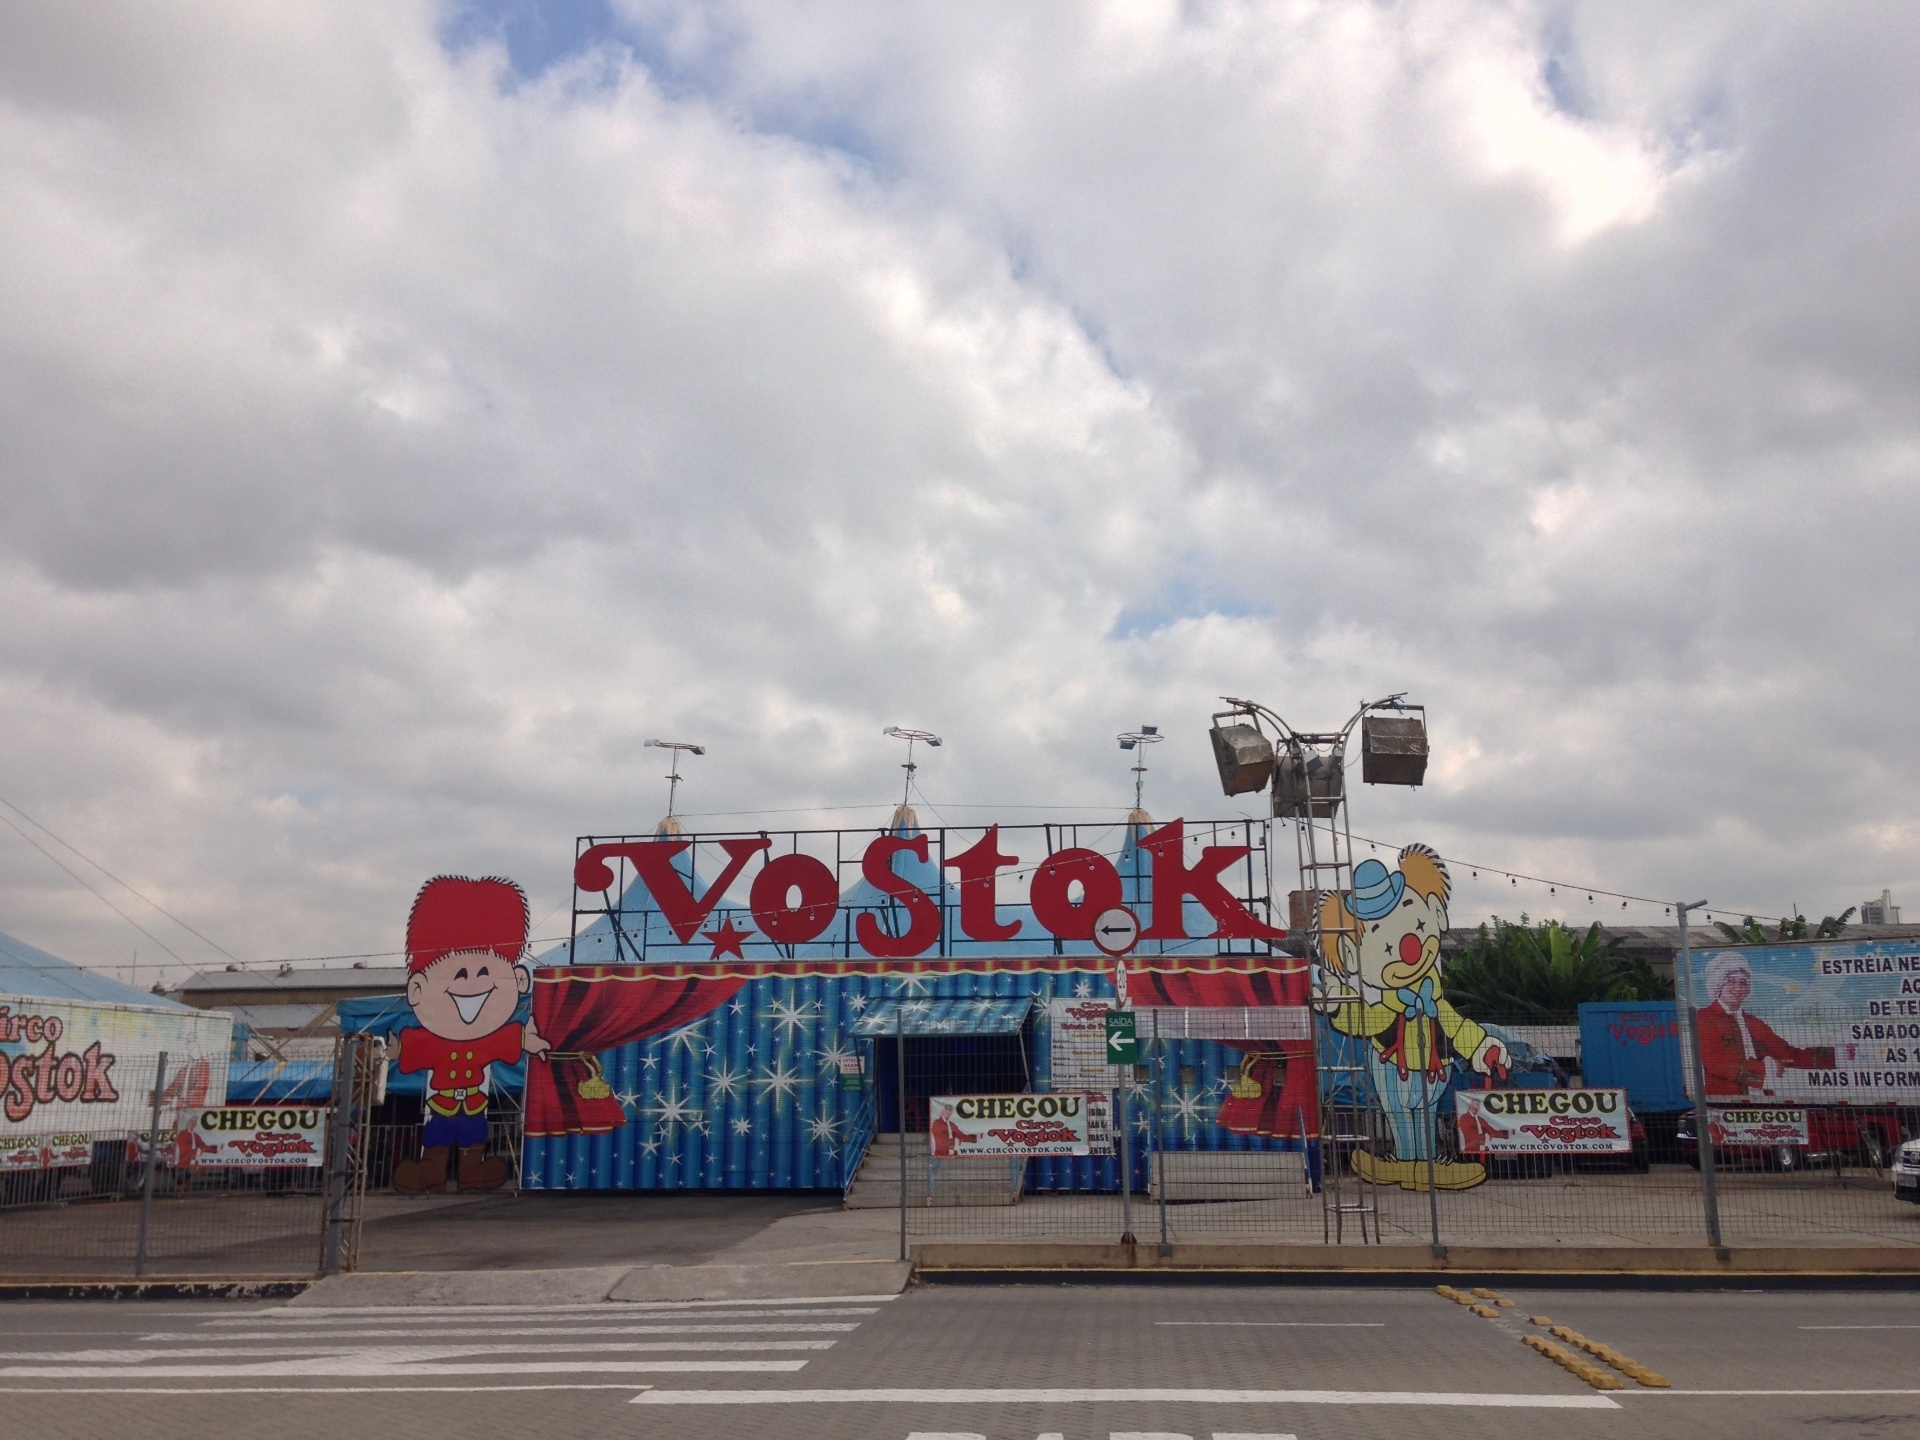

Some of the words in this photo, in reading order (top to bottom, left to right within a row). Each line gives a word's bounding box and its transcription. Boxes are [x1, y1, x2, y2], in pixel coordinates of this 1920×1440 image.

[1822, 954, 1893, 975] ESTRÉIA
[1869, 1001, 1892, 1016] DE
[0, 1006, 63, 1043] irco
[1108, 1015, 1133, 1025] SAÍDA
[1886, 1048, 1907, 1063] AS
[1808, 1072, 1849, 1087] MAIS
[956, 1097, 1081, 1119] CHEGOU
[1483, 1091, 1618, 1115] CHEGOU
[200, 1110, 320, 1131] CHEGOU
[1015, 1119, 1065, 1130] Circo
[1549, 1115, 1602, 1126] Circo
[1722, 1111, 1802, 1124] CHEGOU
[52, 1133, 92, 1147] CHEGOU
[255, 1131, 303, 1142] Circo
[988, 1127, 1082, 1147] Vostok
[1520, 1124, 1622, 1144] Vostok
[228, 1139, 318, 1158] Vostok
[959, 1146, 1073, 1154] WWW.CIRCOVOSTOK.COM
